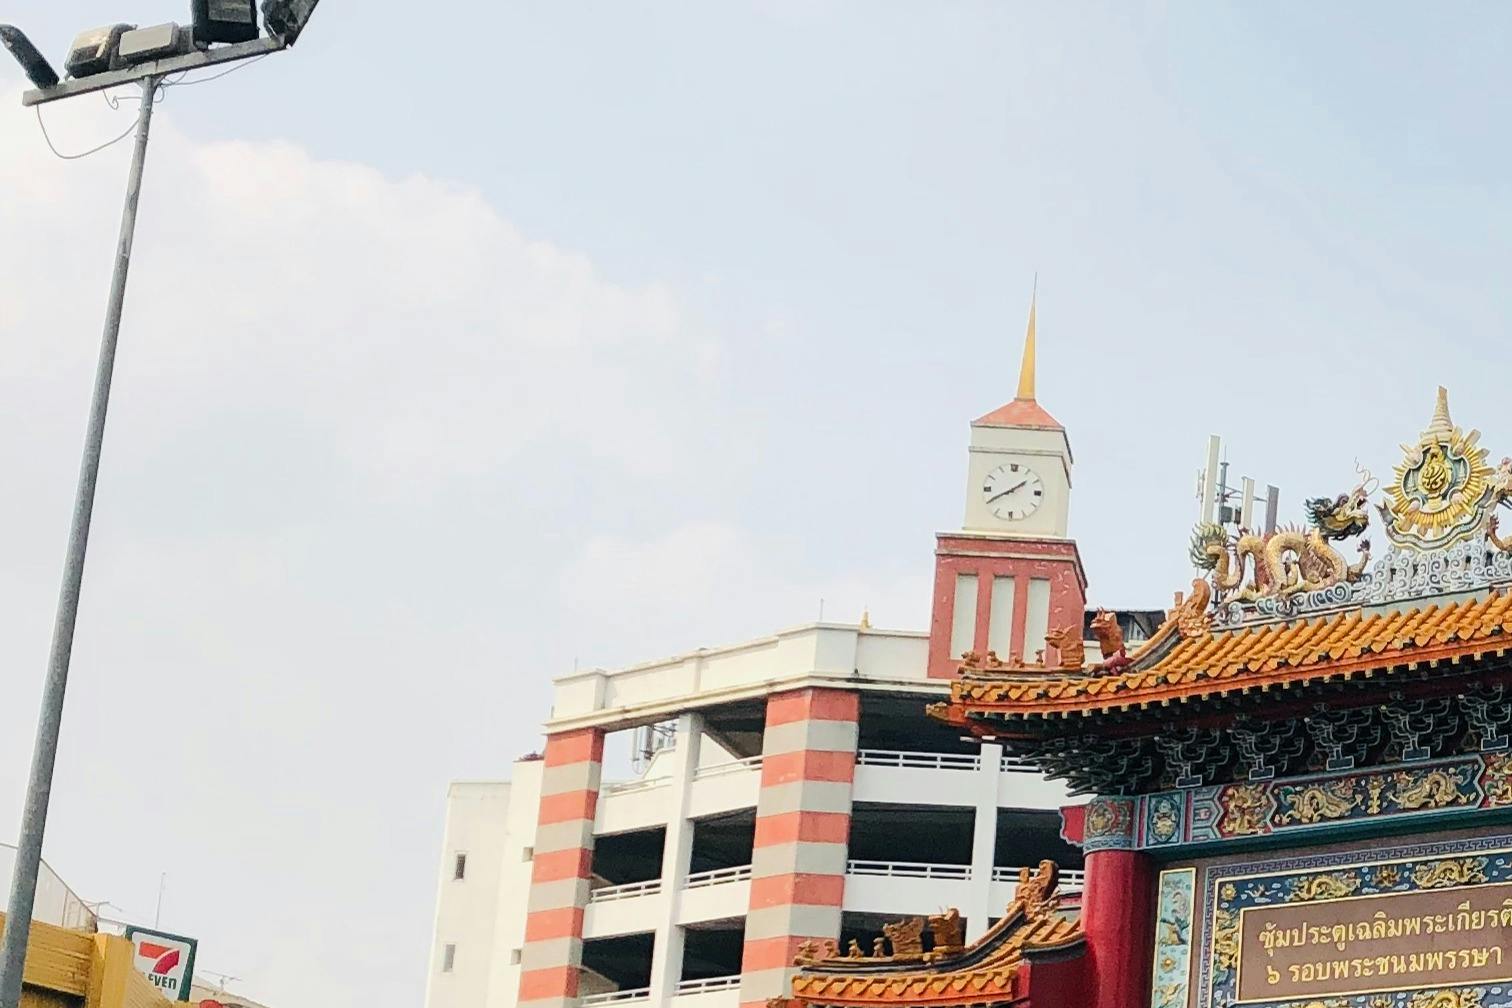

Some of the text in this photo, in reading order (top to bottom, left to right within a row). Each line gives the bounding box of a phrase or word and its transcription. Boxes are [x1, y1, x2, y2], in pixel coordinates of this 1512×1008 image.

[1266, 945, 1502, 985] ๖ รอบพระชนมพรรษา
